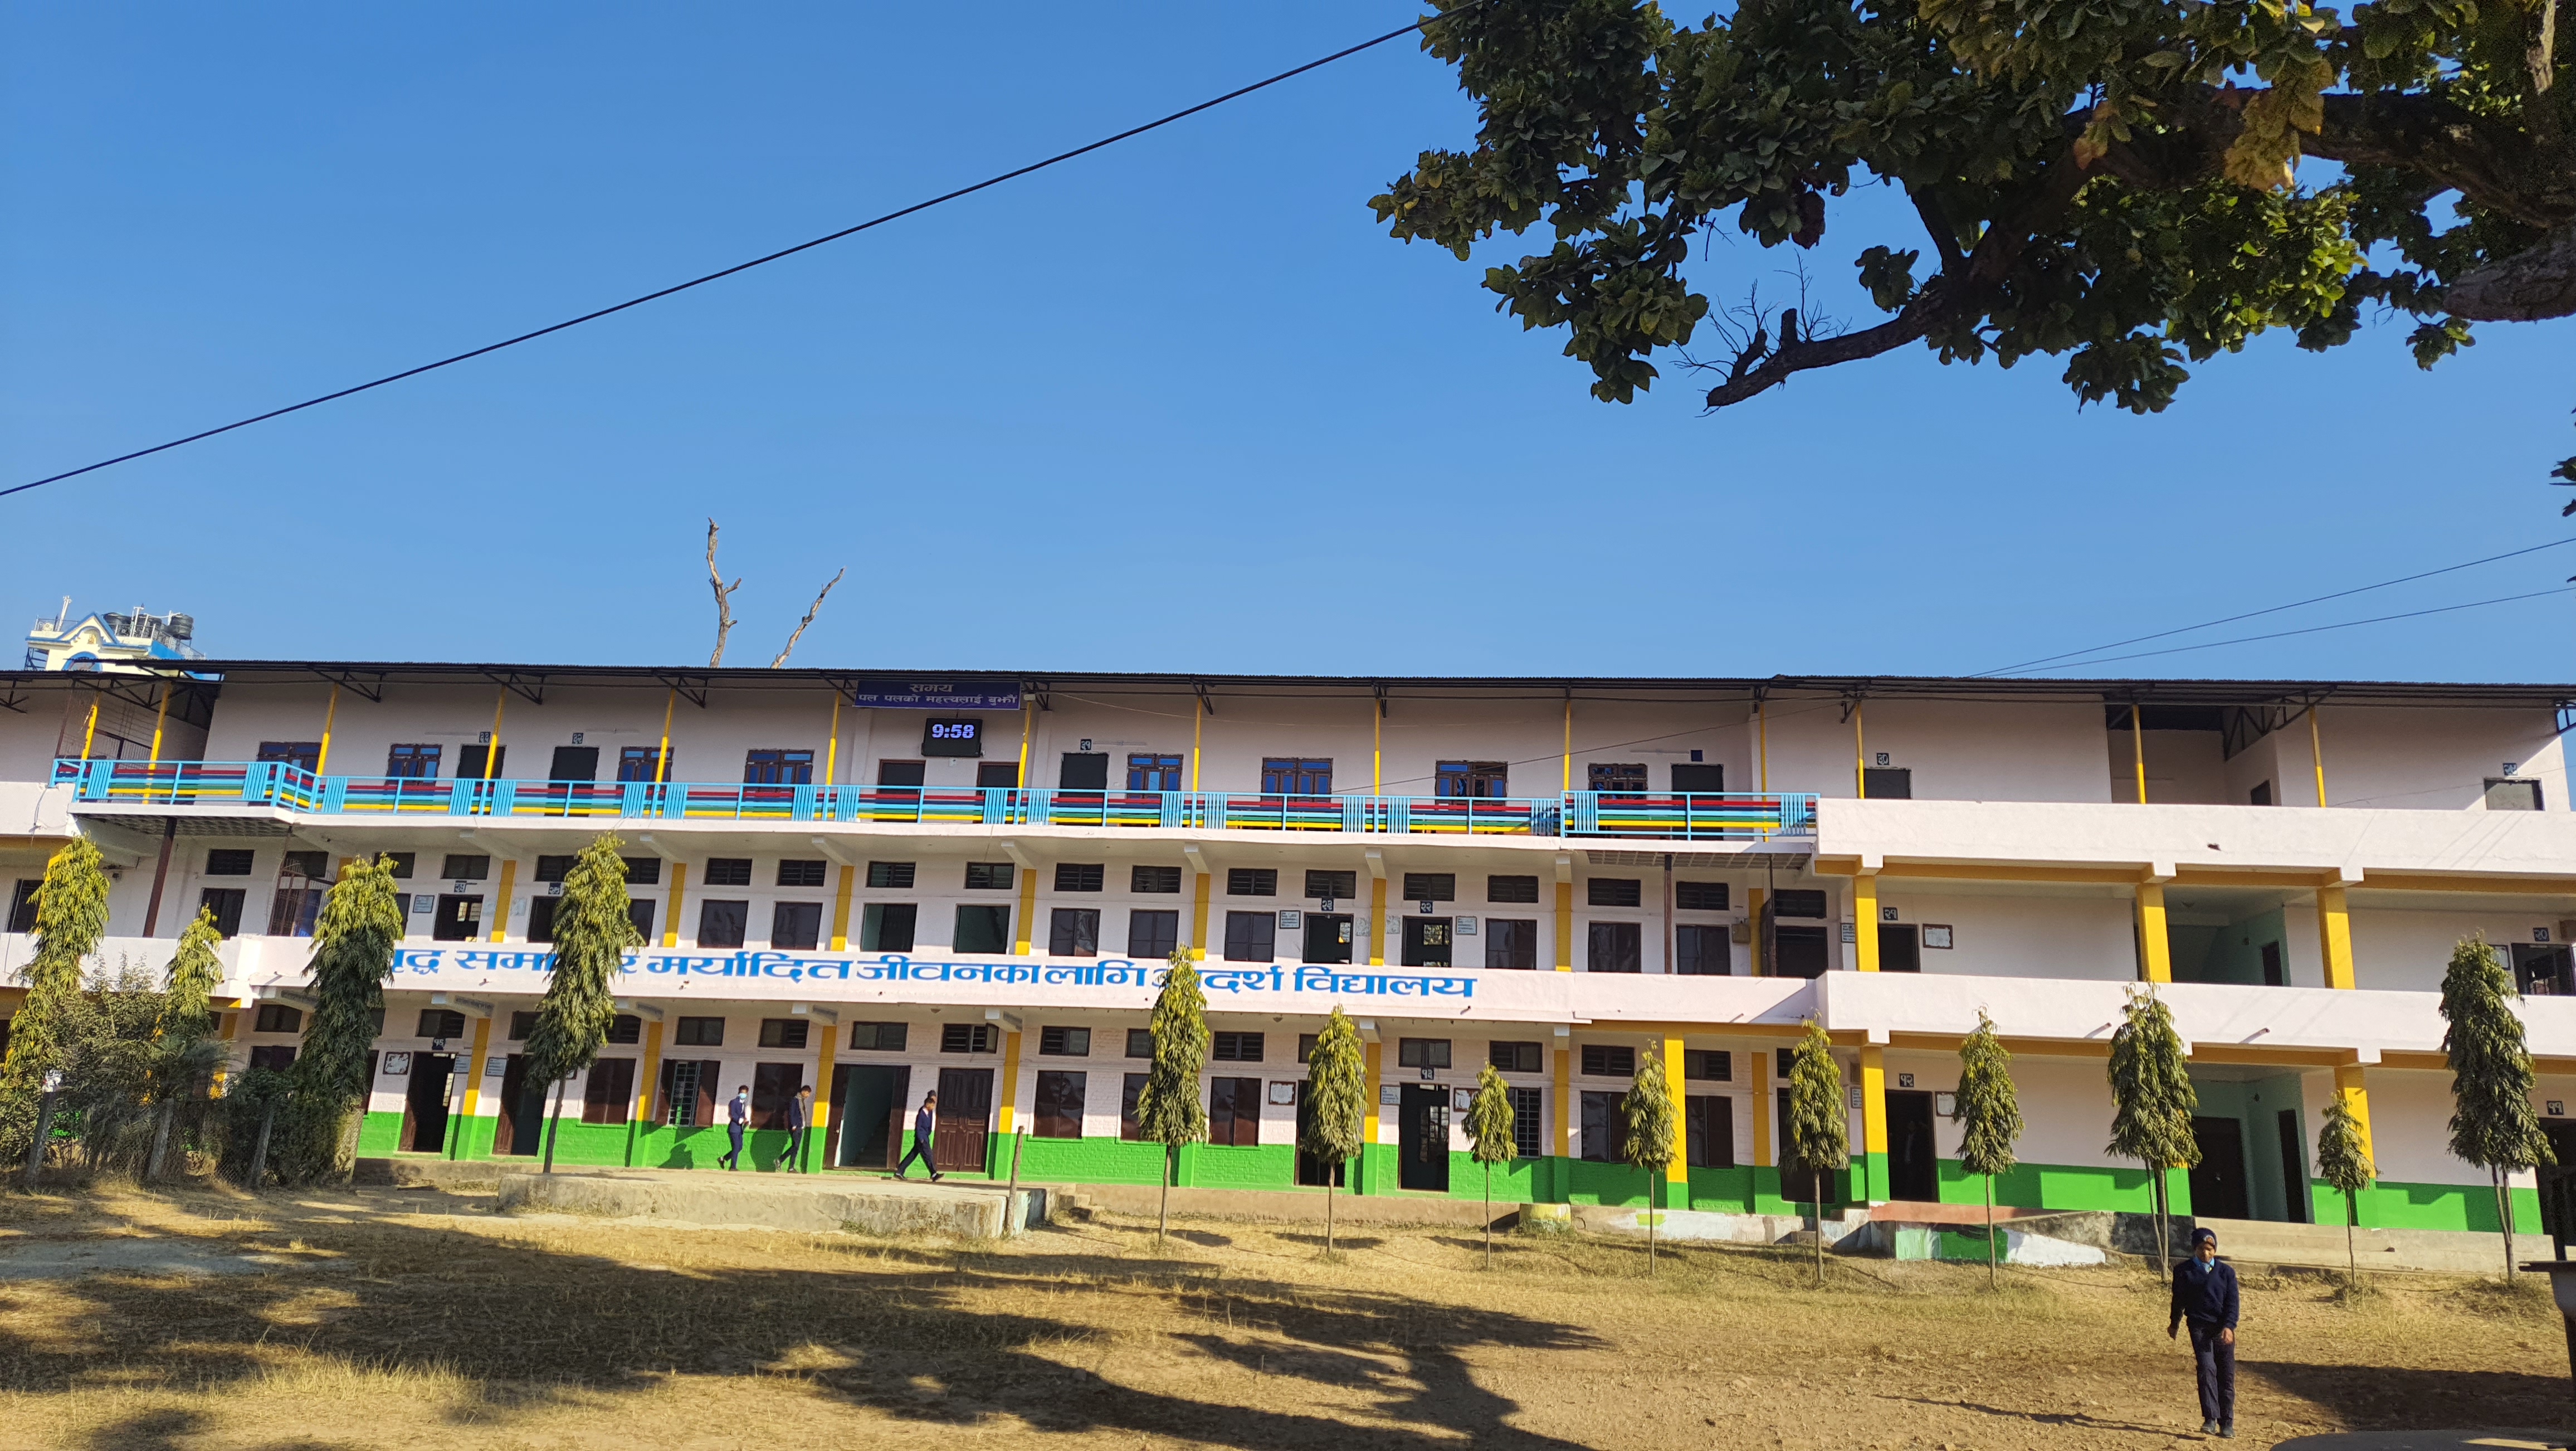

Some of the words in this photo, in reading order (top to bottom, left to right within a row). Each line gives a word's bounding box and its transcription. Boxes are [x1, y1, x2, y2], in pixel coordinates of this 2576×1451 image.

[909, 683, 954, 693] समय
[858, 694, 879, 702] पल
[884, 693, 921, 703] पलको
[932, 724, 975, 739] 9:58
[1421, 902, 1432, 913] २२
[1884, 908, 1897, 921] २१
[646, 951, 855, 983] मर्यादित
[856, 955, 1041, 984] जीवनका
[1045, 960, 1148, 987] लागि
[1294, 966, 1478, 997] विद्यालय
[1900, 1074, 1914, 1087] १२
[2547, 1101, 2563, 1114] ११
